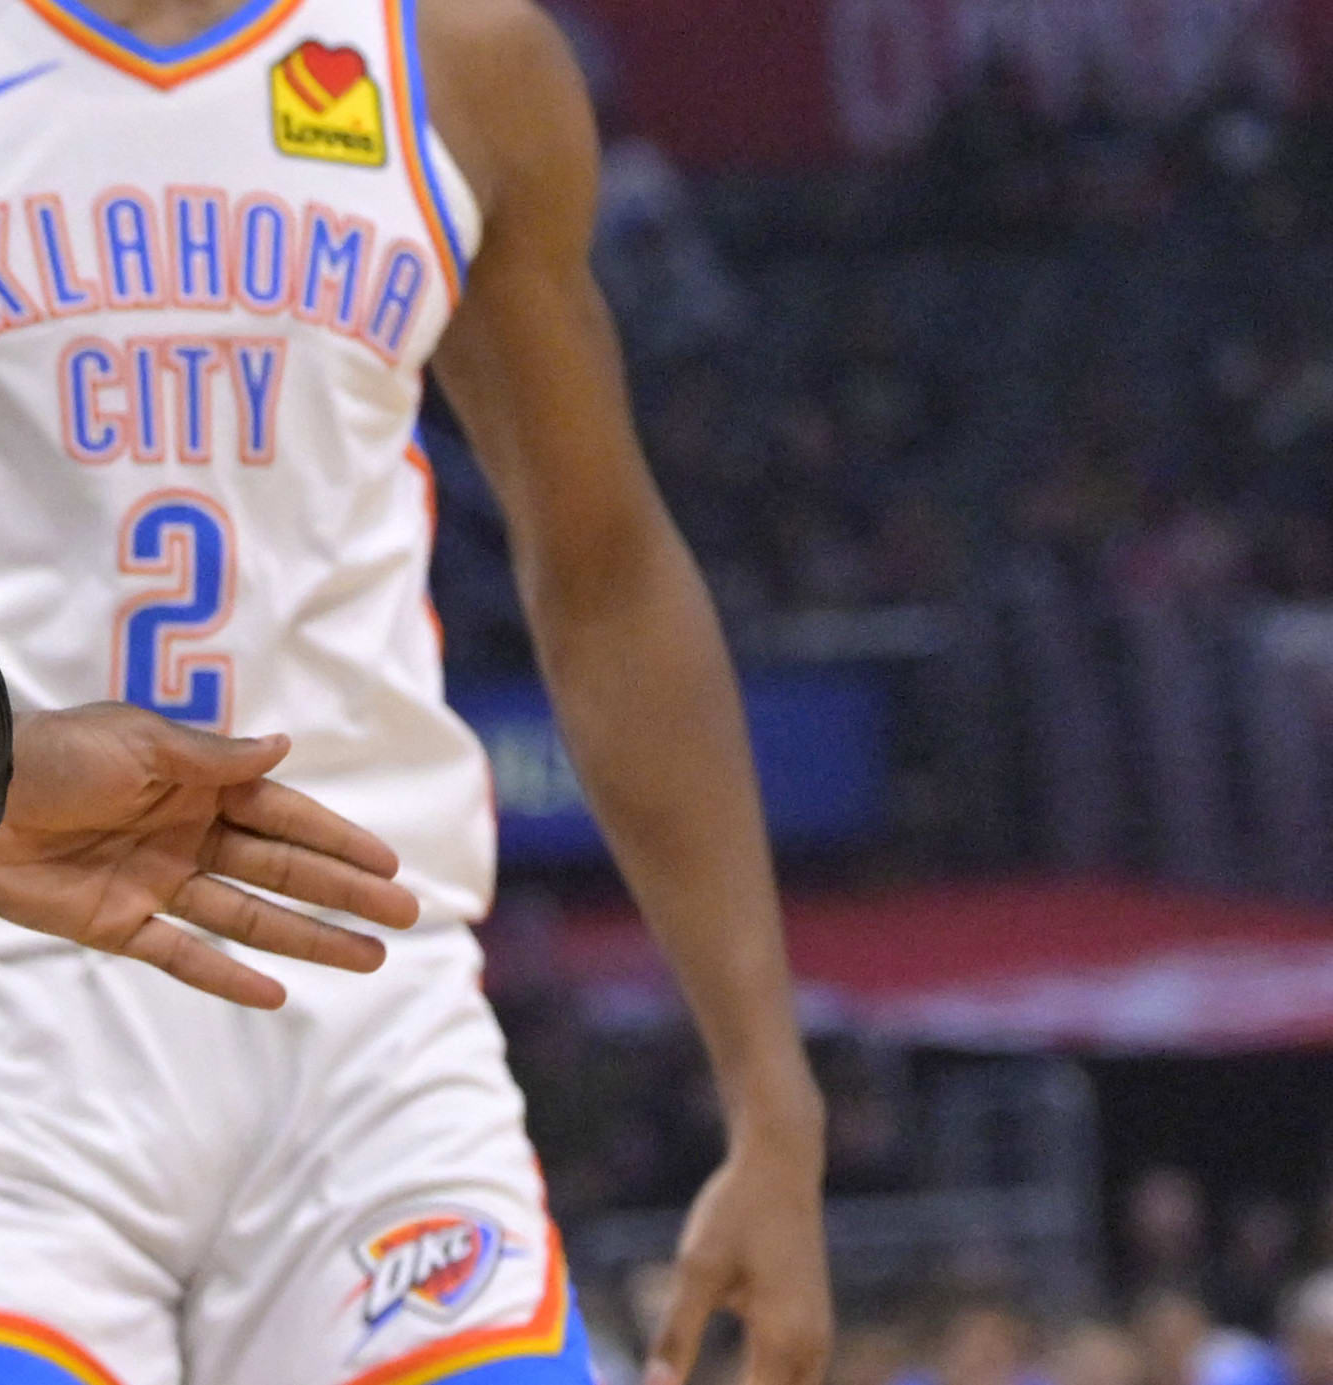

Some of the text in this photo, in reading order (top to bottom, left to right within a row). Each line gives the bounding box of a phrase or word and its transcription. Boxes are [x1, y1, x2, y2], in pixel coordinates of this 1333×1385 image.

[58, 335, 287, 465] CITY
[109, 487, 235, 734] 2
[362, 1221, 476, 1325] OKC
